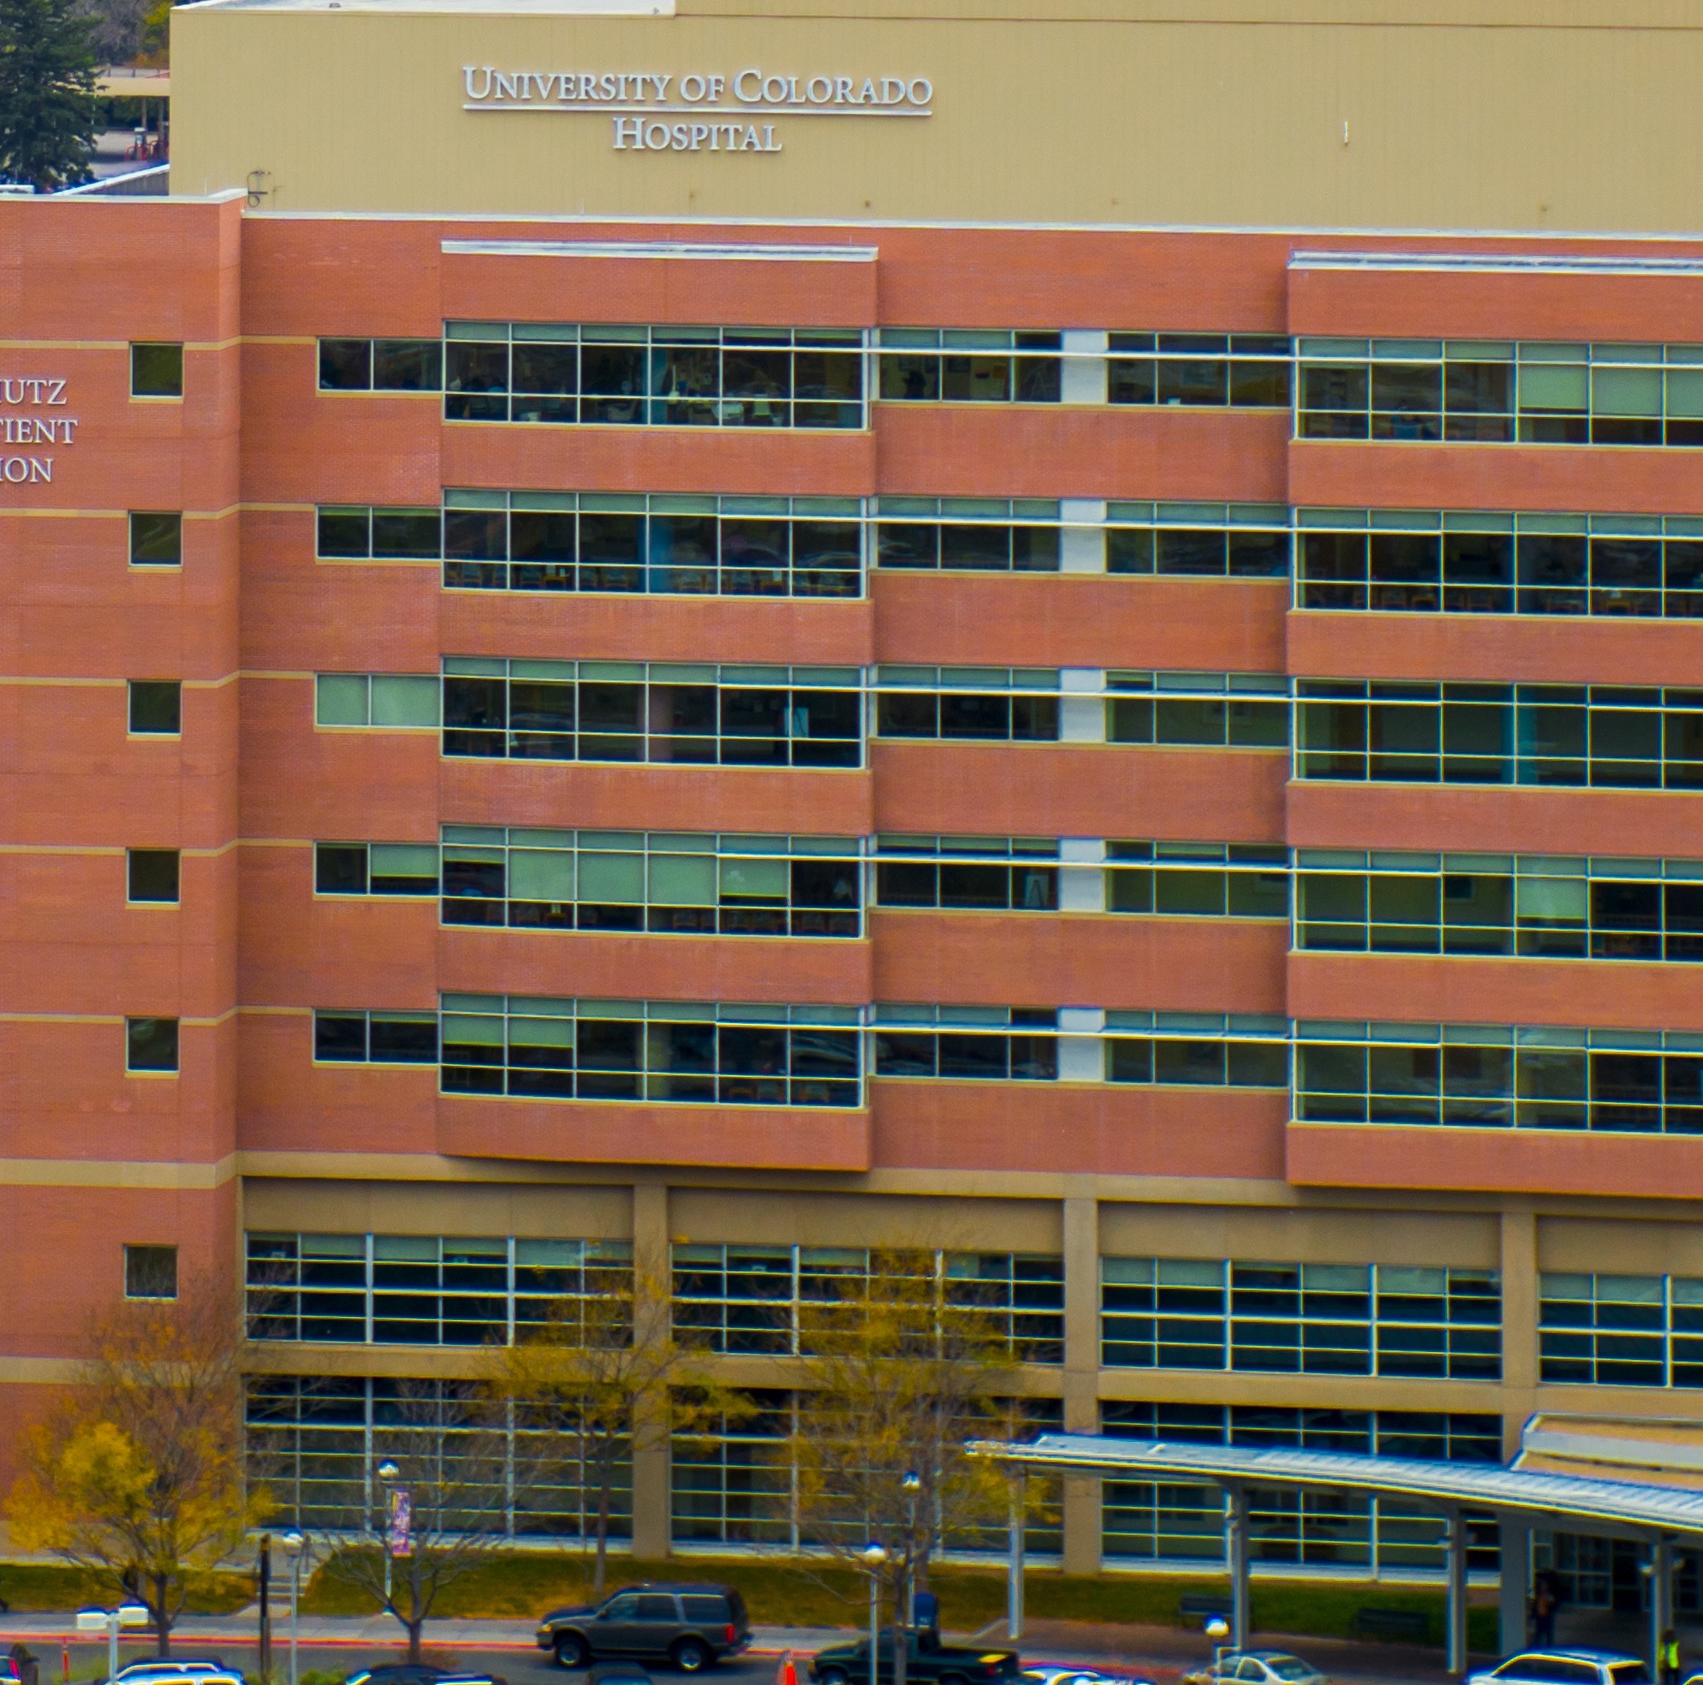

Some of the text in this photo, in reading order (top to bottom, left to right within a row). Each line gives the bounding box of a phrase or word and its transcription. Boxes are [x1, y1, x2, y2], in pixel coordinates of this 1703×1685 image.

[462, 66, 934, 105] UNIVERSITY OF COLORADO
[612, 117, 783, 152] HOSPITAL
